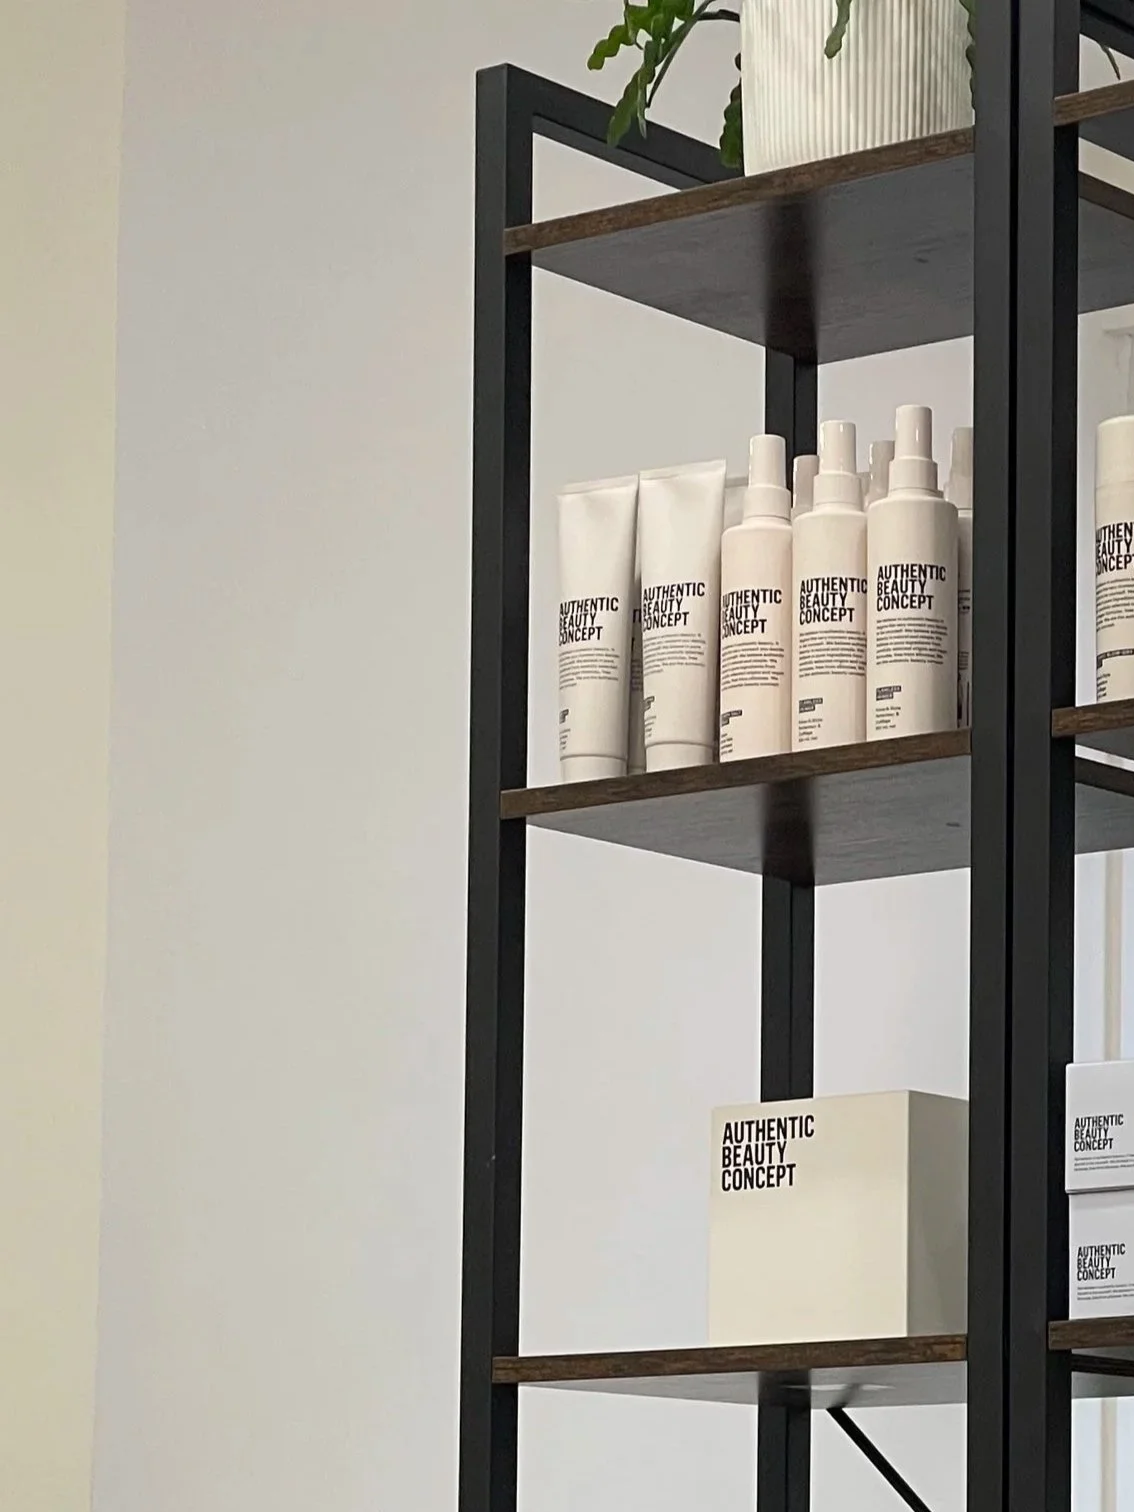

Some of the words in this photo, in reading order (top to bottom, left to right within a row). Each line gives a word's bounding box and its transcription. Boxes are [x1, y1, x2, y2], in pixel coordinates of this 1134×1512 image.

[877, 564, 946, 581] AUTHENTIC
[643, 582, 705, 601] AUTHENTIC
[800, 578, 867, 594] AUTHENTIC
[877, 579, 926, 596] BEAUTY
[560, 597, 619, 616] AUTHENTIC
[800, 592, 848, 610] BEAUTY
[877, 595, 934, 611] CONCEPT
[799, 607, 854, 625] CONCEPT
[723, 1115, 814, 1145] AUTHENTIC
[1075, 1114, 1124, 1129] AUTHENTIC
[1074, 1128, 1108, 1140] BEAUTY
[1074, 1139, 1114, 1152] CONCEPT
[722, 1141, 787, 1168] BEAUTY
[721, 1164, 796, 1191] CONCEPT
[1078, 1243, 1125, 1257] AUTHENTIC
[1077, 1257, 1111, 1270] BEAUTY
[1077, 1267, 1116, 1281] CONCEPT
